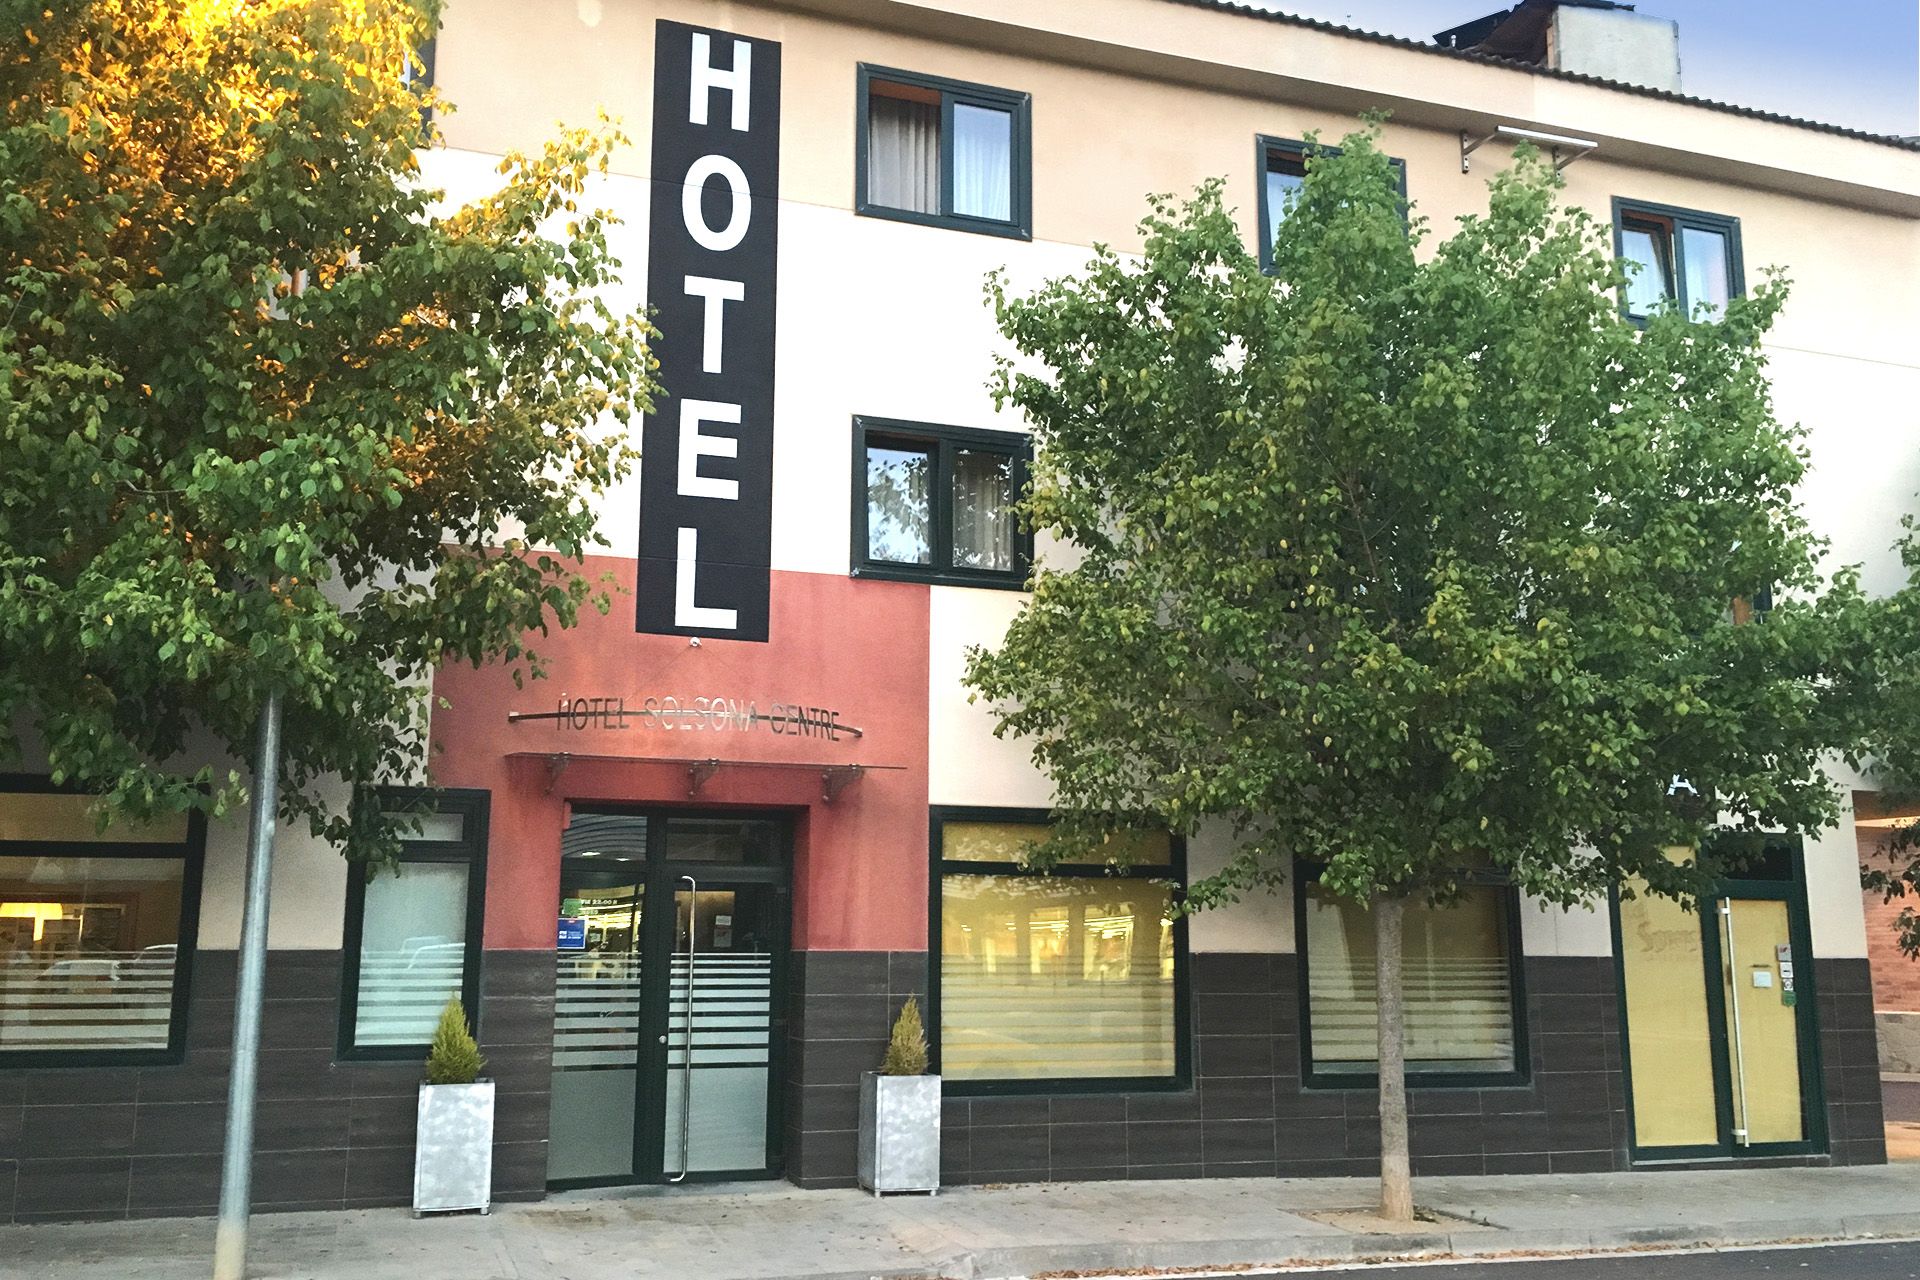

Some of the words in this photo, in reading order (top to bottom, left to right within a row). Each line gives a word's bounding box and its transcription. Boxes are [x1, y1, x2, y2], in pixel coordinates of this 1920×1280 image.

[675, 32, 752, 630] HOTEL
[557, 698, 630, 731] HOTEL
[644, 696, 759, 732] SOLSONA
[770, 702, 840, 742] CENTRE
